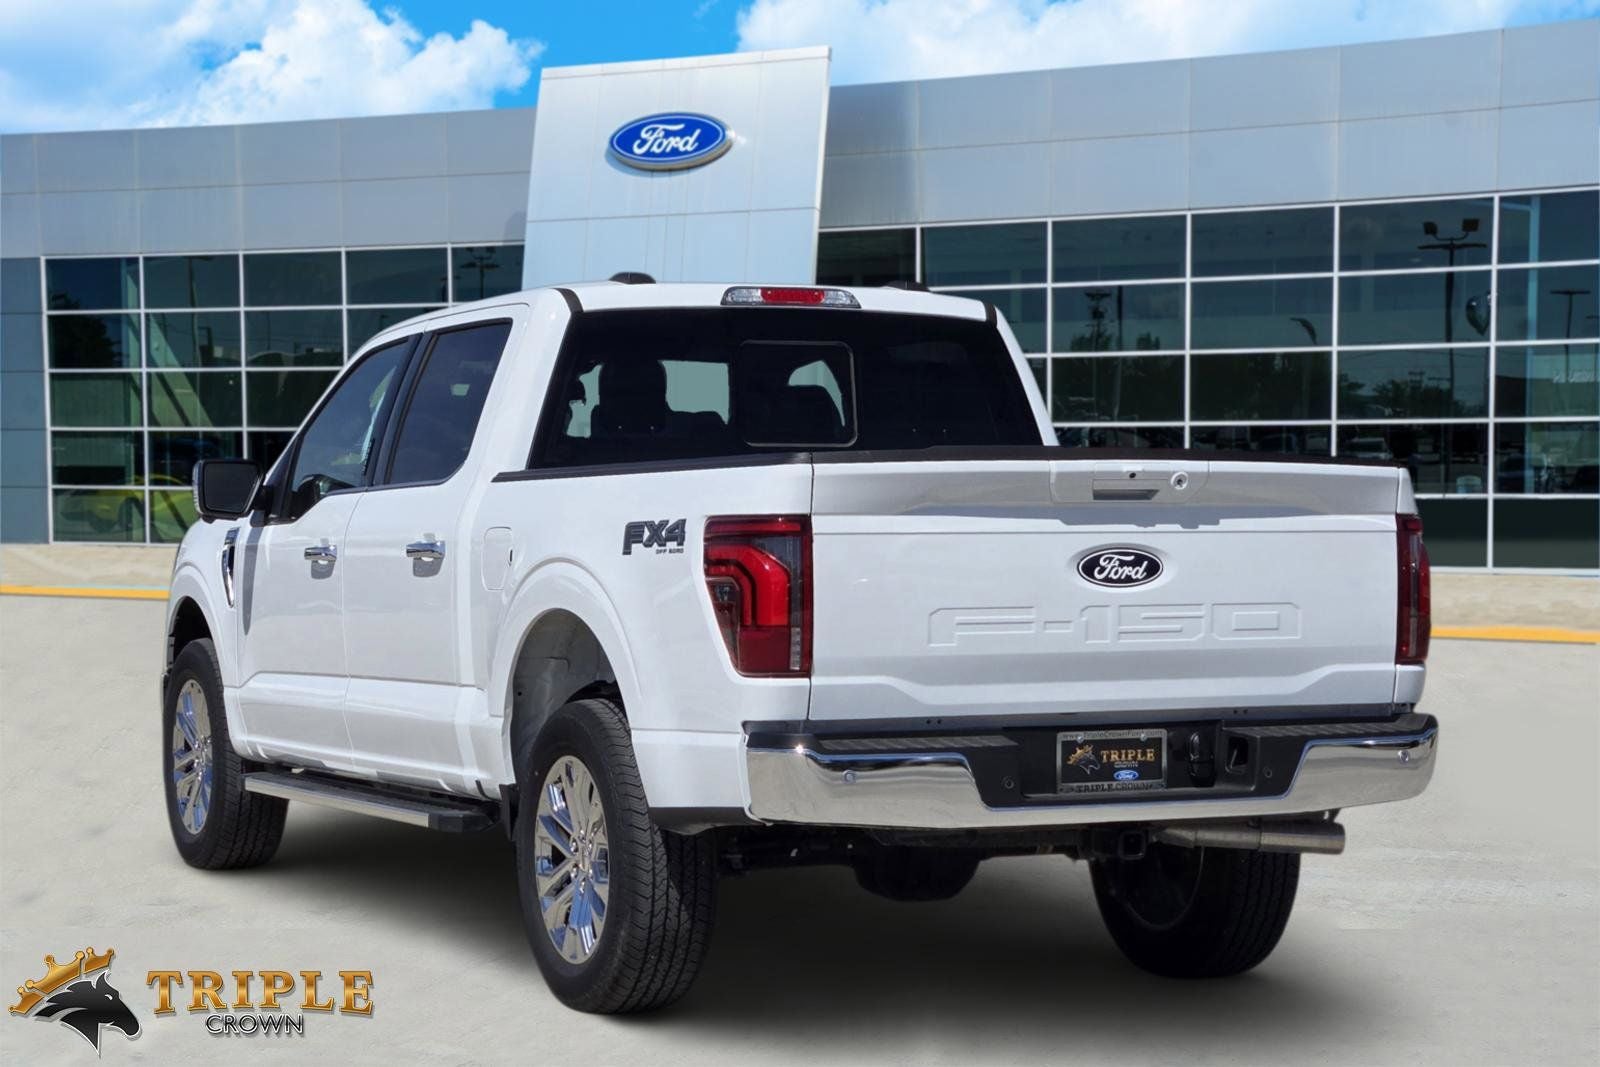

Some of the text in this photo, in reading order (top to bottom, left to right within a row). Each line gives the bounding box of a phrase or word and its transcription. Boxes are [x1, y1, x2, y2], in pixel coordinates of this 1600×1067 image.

[632, 123, 701, 155] Ford
[622, 518, 687, 555] FX4
[1093, 554, 1148, 580] Ford
[927, 602, 1303, 648] F-150
[1101, 749, 1155, 763] TRIPLE
[1075, 784, 1113, 793] TRIPLE
